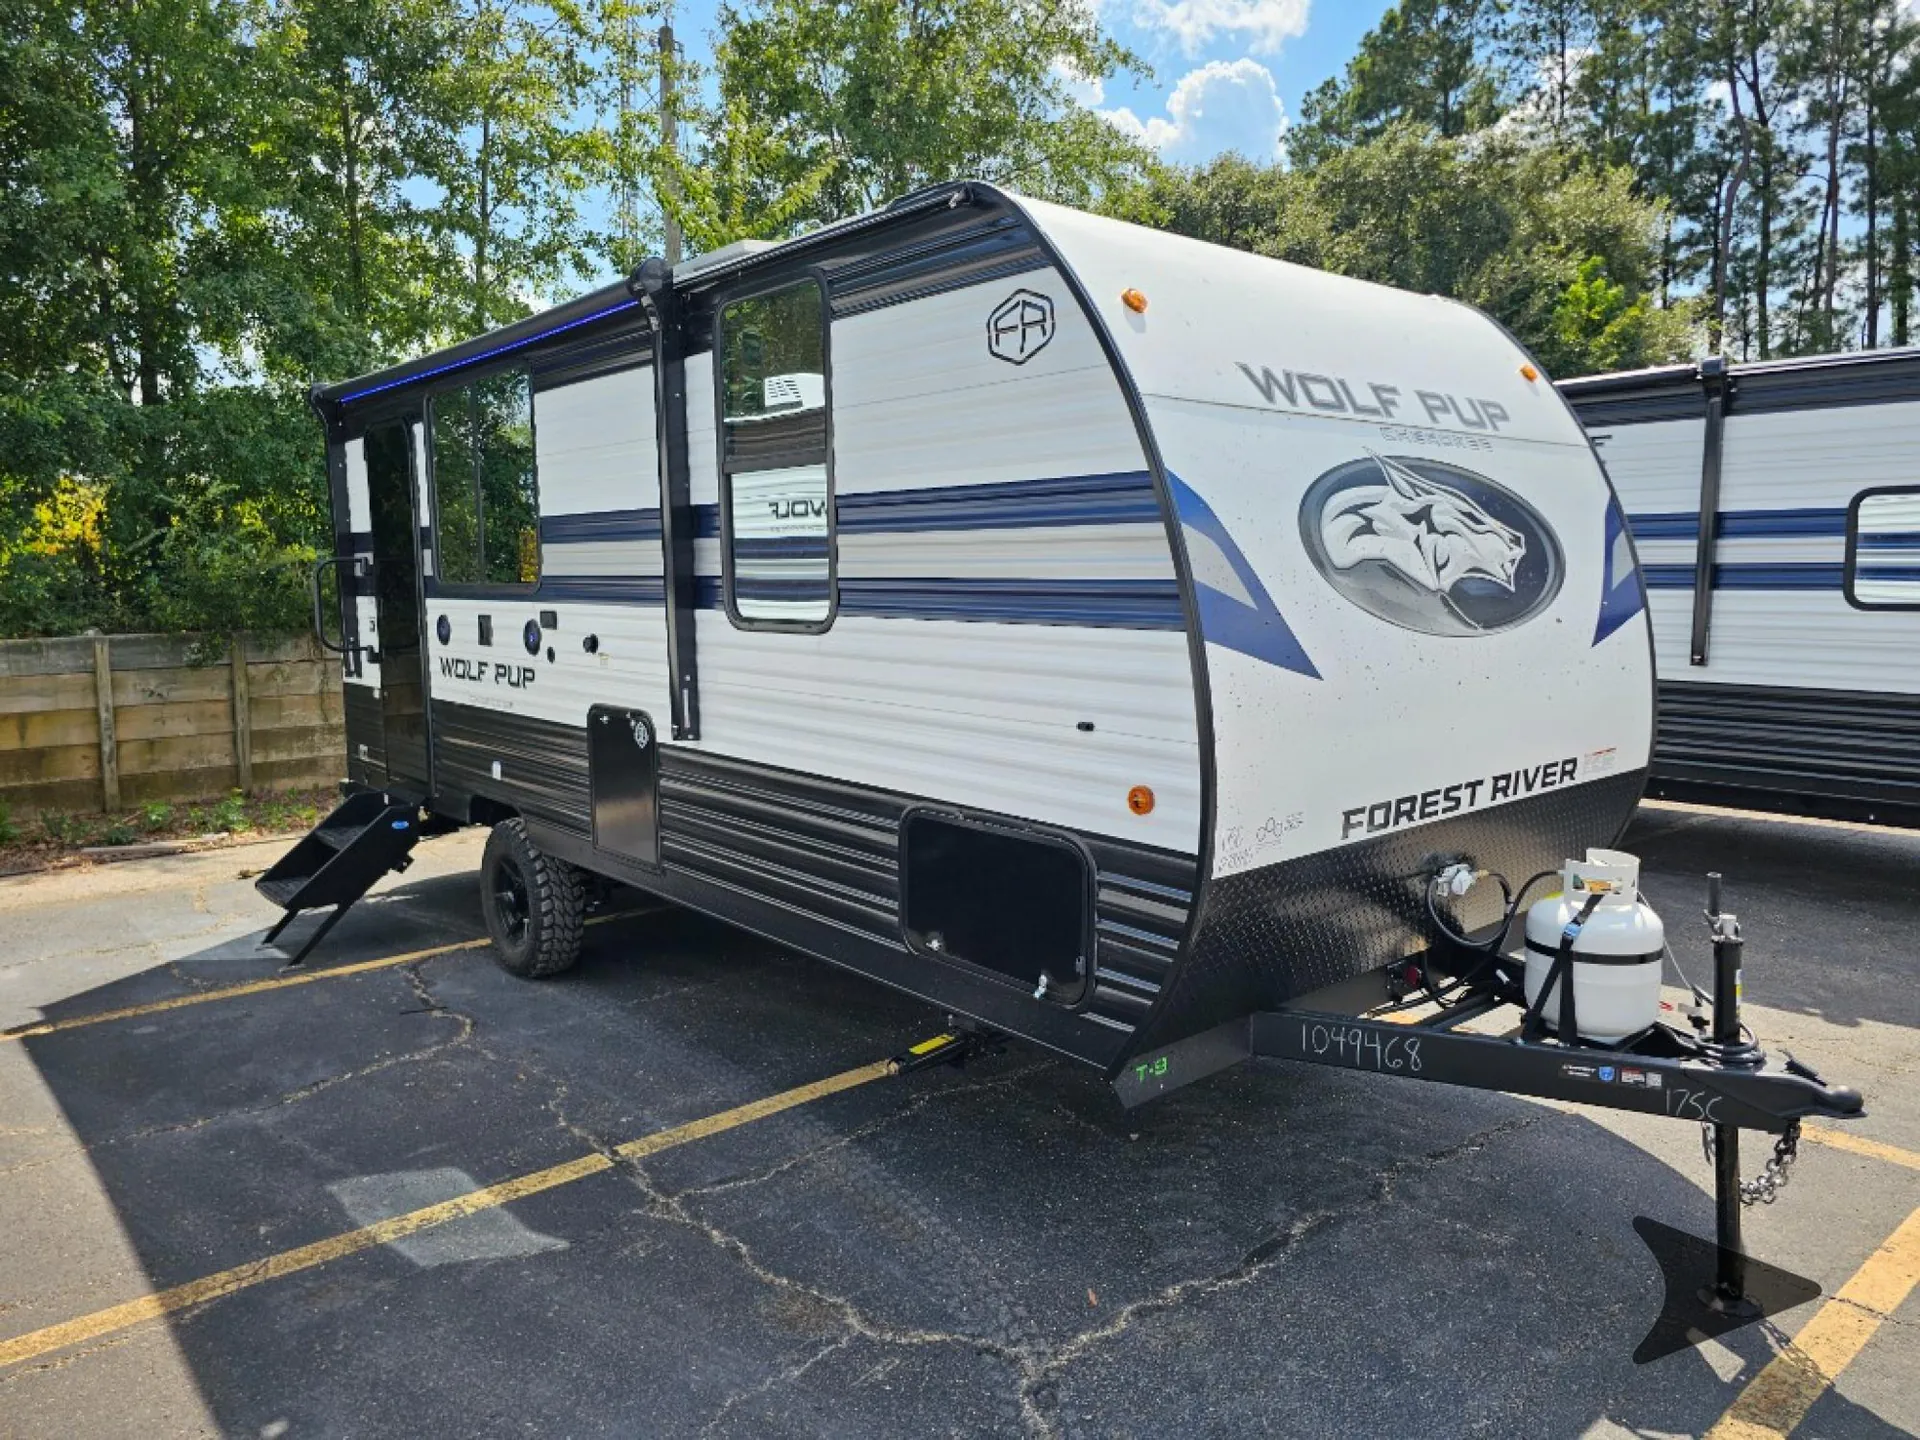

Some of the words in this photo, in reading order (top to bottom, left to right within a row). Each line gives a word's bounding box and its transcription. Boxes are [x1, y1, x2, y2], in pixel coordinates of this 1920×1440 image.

[1235, 361, 1400, 418] WOLF
[1414, 389, 1511, 432] PUP
[439, 656, 488, 682] WOLF
[494, 663, 535, 689] PUP
[1341, 778, 1485, 840] FOREST
[1490, 757, 1579, 802] RIVER
[1301, 1023, 1422, 1072] 1049468
